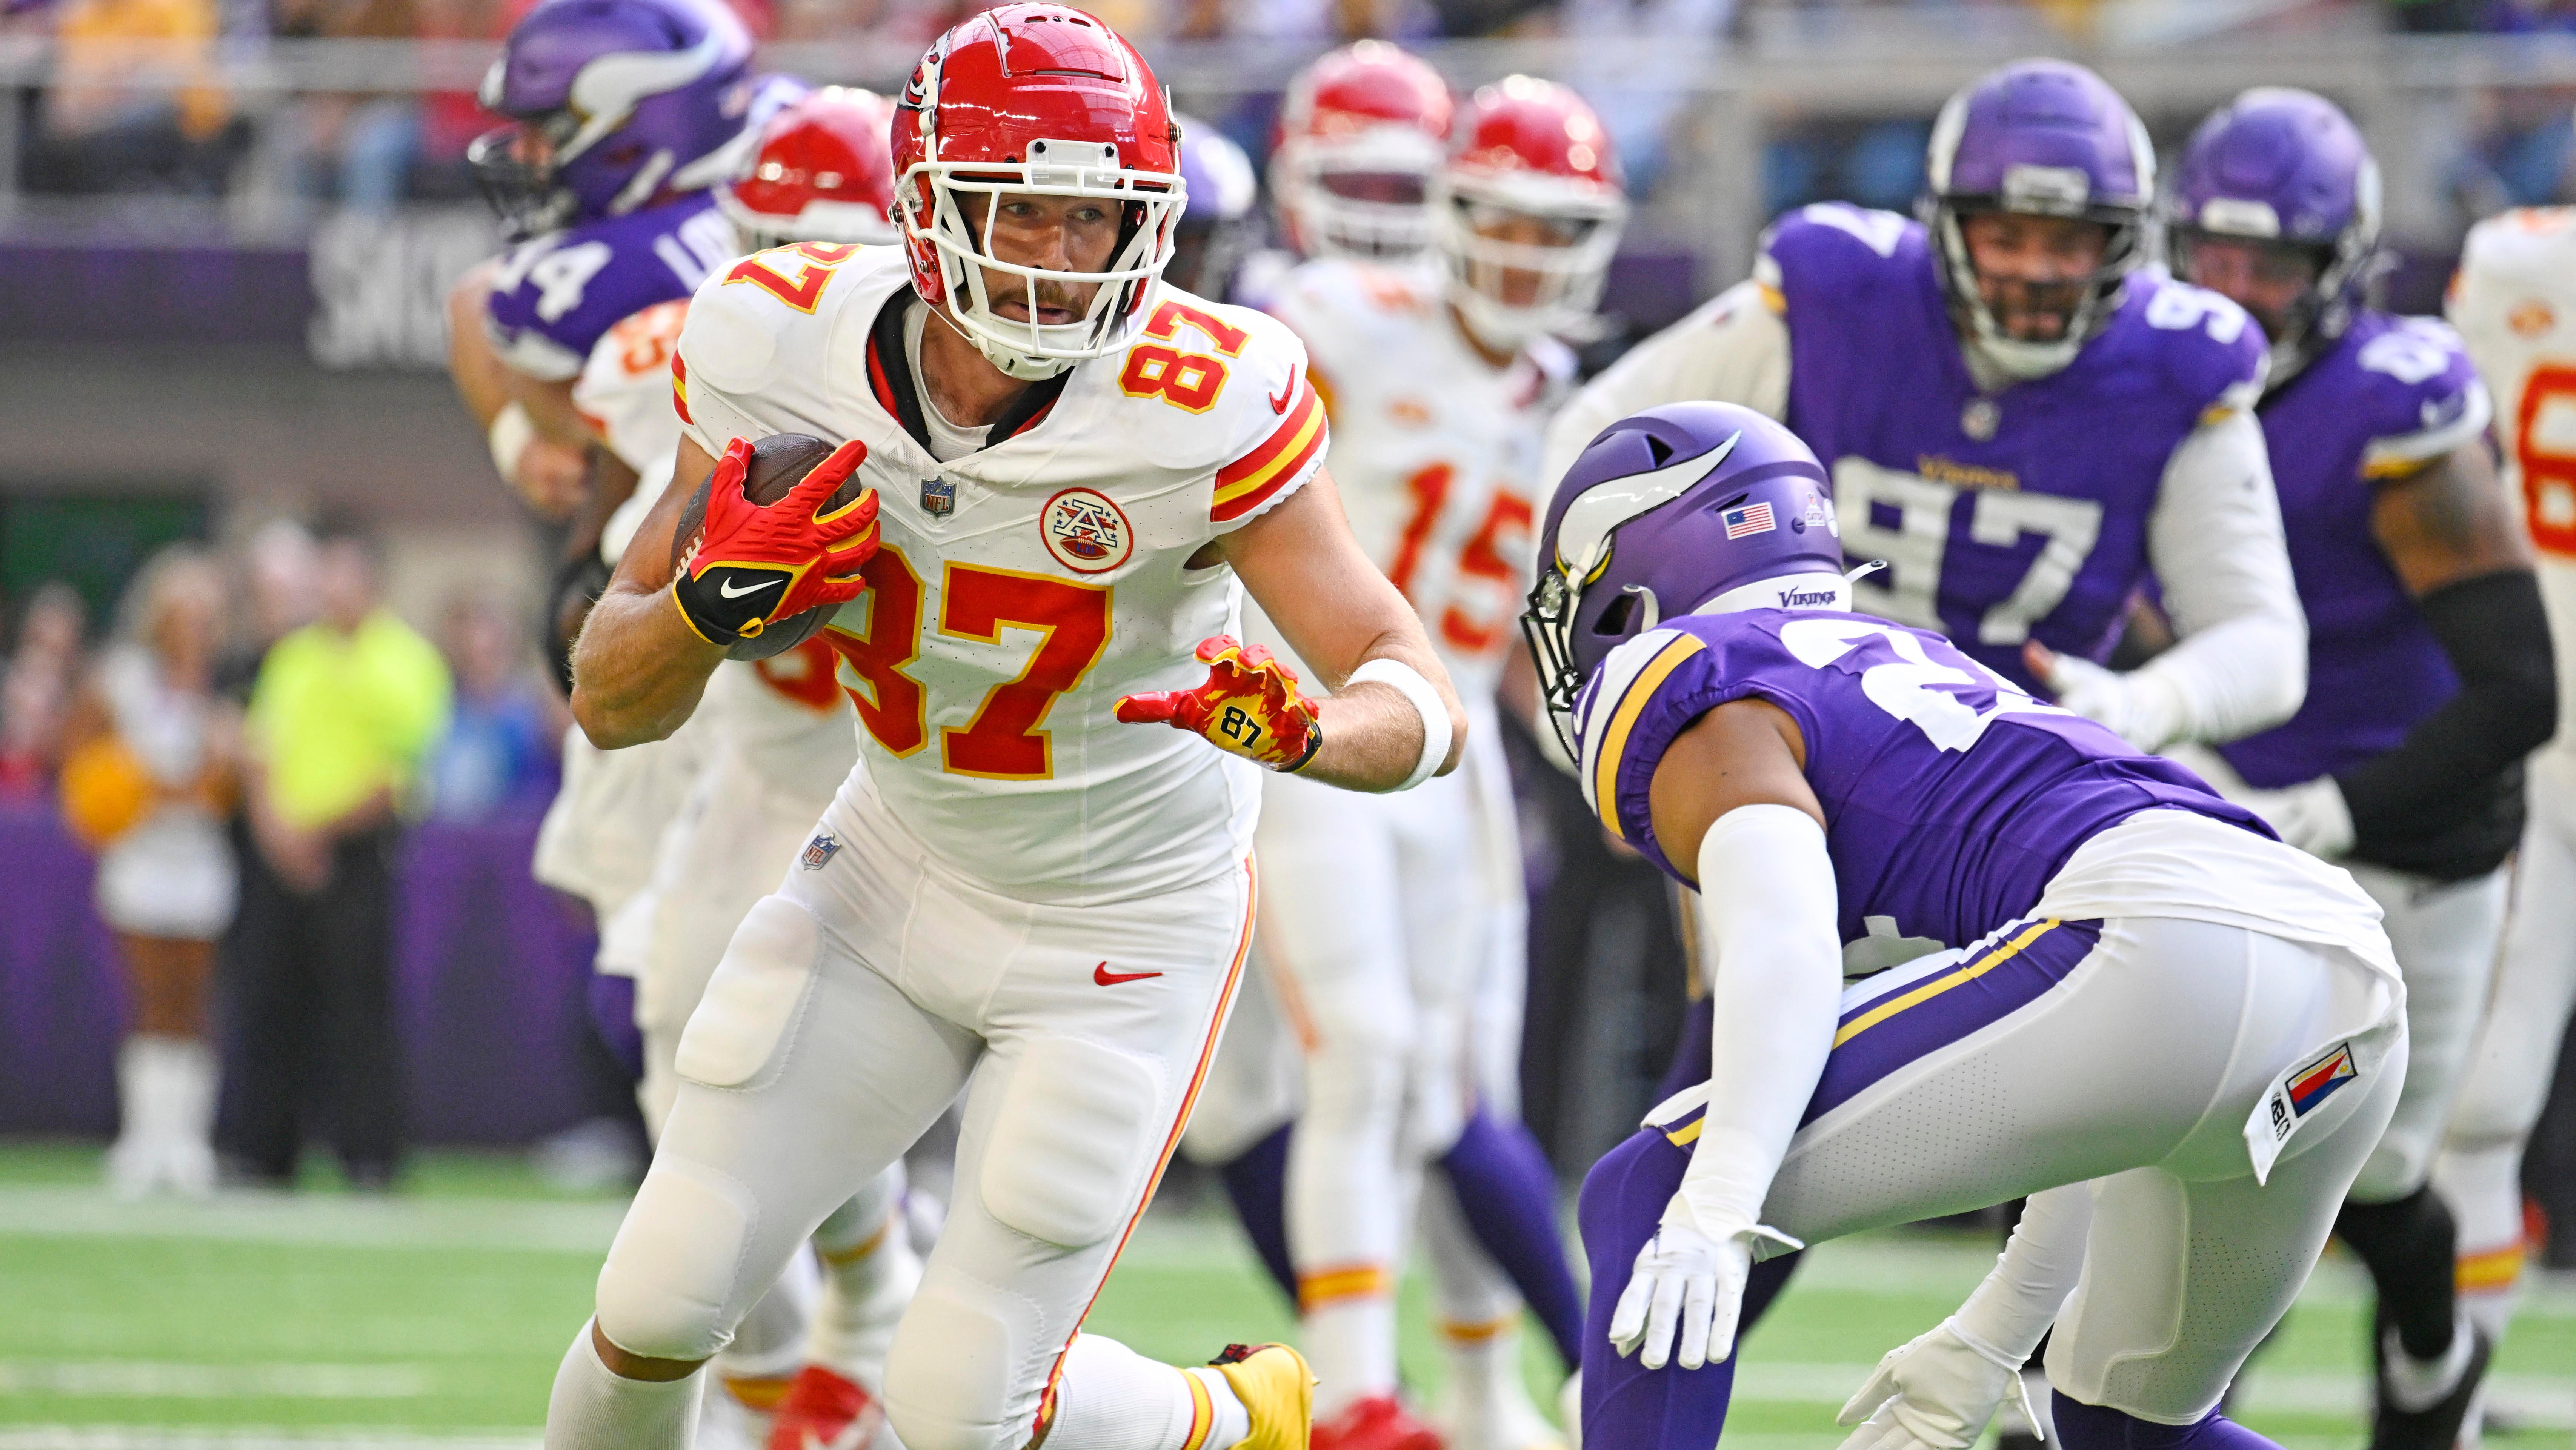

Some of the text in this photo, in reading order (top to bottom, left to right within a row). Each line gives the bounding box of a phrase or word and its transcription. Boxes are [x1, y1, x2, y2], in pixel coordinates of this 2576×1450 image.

[1117, 298, 1253, 415] 87
[926, 494, 949, 512] NFL
[1832, 455, 2104, 647] 97
[823, 541, 1114, 781] 87
[1220, 705, 1263, 750] 87
[805, 846, 824, 864] NFL
